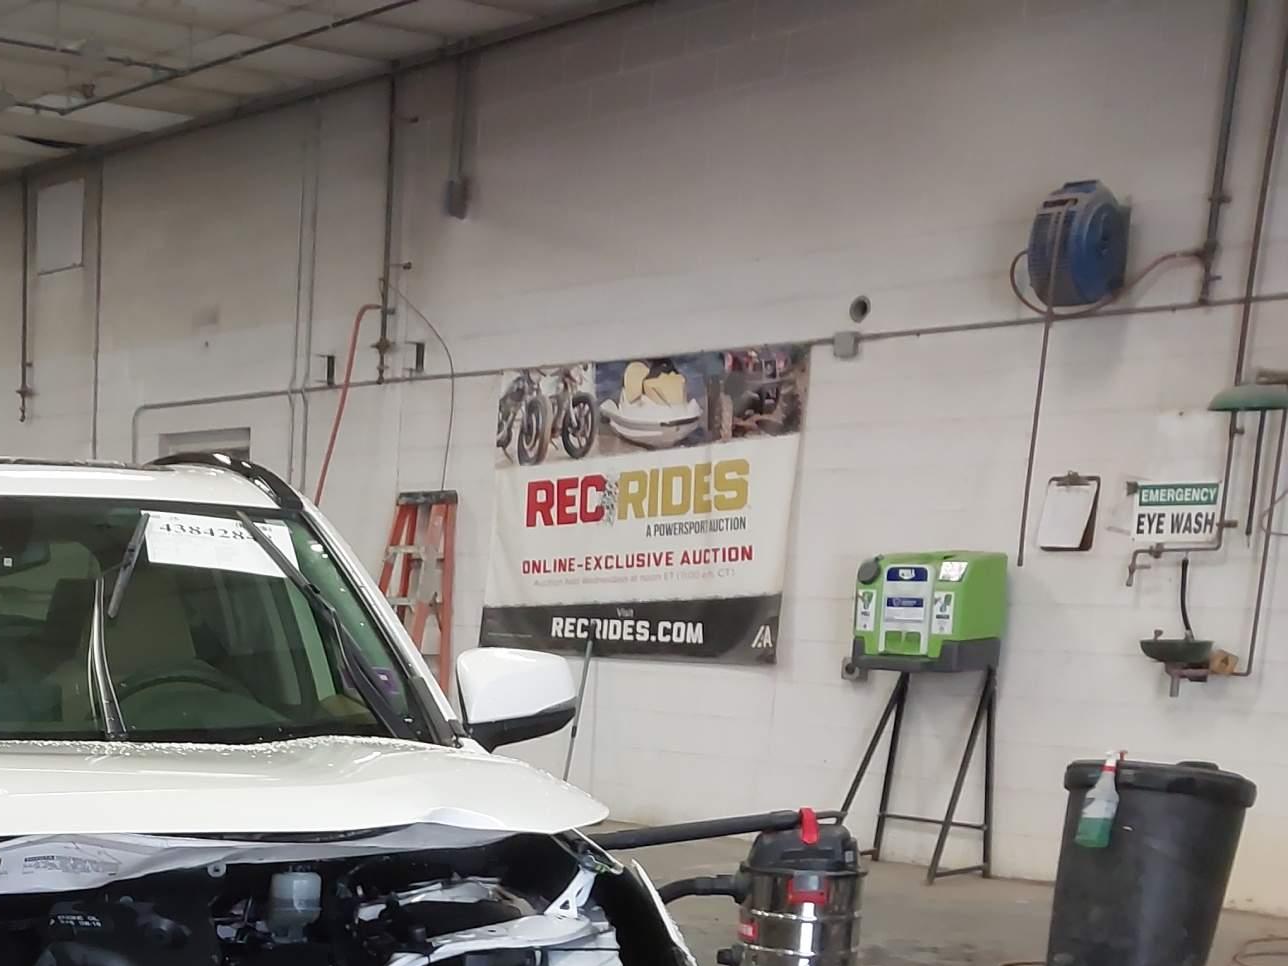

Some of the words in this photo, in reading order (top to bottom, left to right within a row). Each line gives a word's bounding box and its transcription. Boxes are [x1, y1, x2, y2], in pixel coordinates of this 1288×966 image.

[617, 459, 750, 520] RIDES
[1141, 487, 1217, 503] EMERGENCY
[646, 524, 652, 538] A
[709, 516, 747, 532] AUCTION
[1136, 512, 1166, 535] EYE
[1170, 511, 1216, 534] WASH
[522, 551, 674, 575] ONLINE-EXCLUSIVE
[680, 545, 753, 566] AUCTION
[551, 616, 704, 645] RECRIDES.COM
